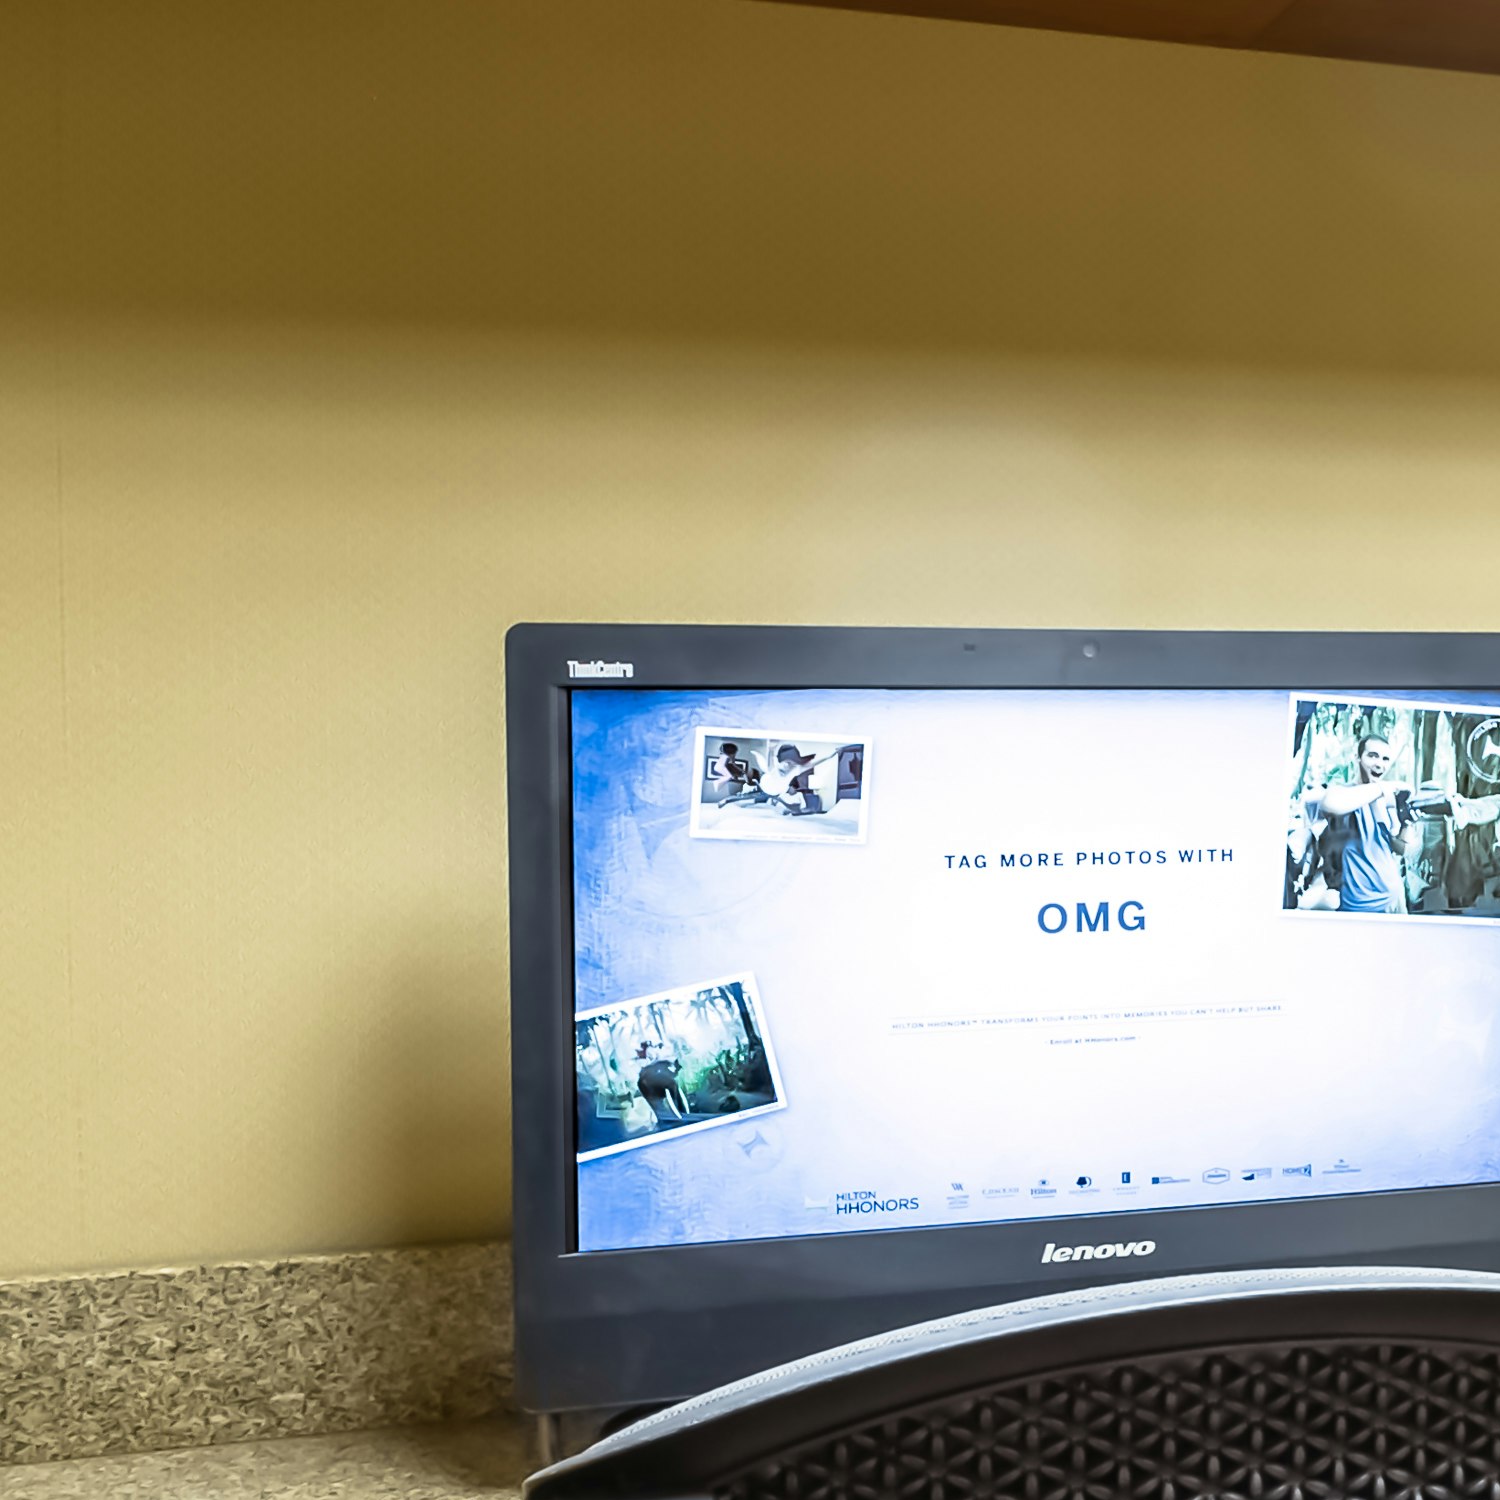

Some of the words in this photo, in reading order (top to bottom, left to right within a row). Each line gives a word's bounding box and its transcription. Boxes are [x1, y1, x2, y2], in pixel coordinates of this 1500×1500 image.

[944, 854, 988, 869] TAG
[1000, 852, 1064, 868] MORE
[1076, 850, 1167, 866] PHOTOS
[1178, 848, 1233, 863] WITH
[1037, 900, 1146, 934] OMG
[836, 1190, 877, 1201] HILTON
[836, 1197, 920, 1215] HHONORS
[1041, 1240, 1156, 1263] lenovo
